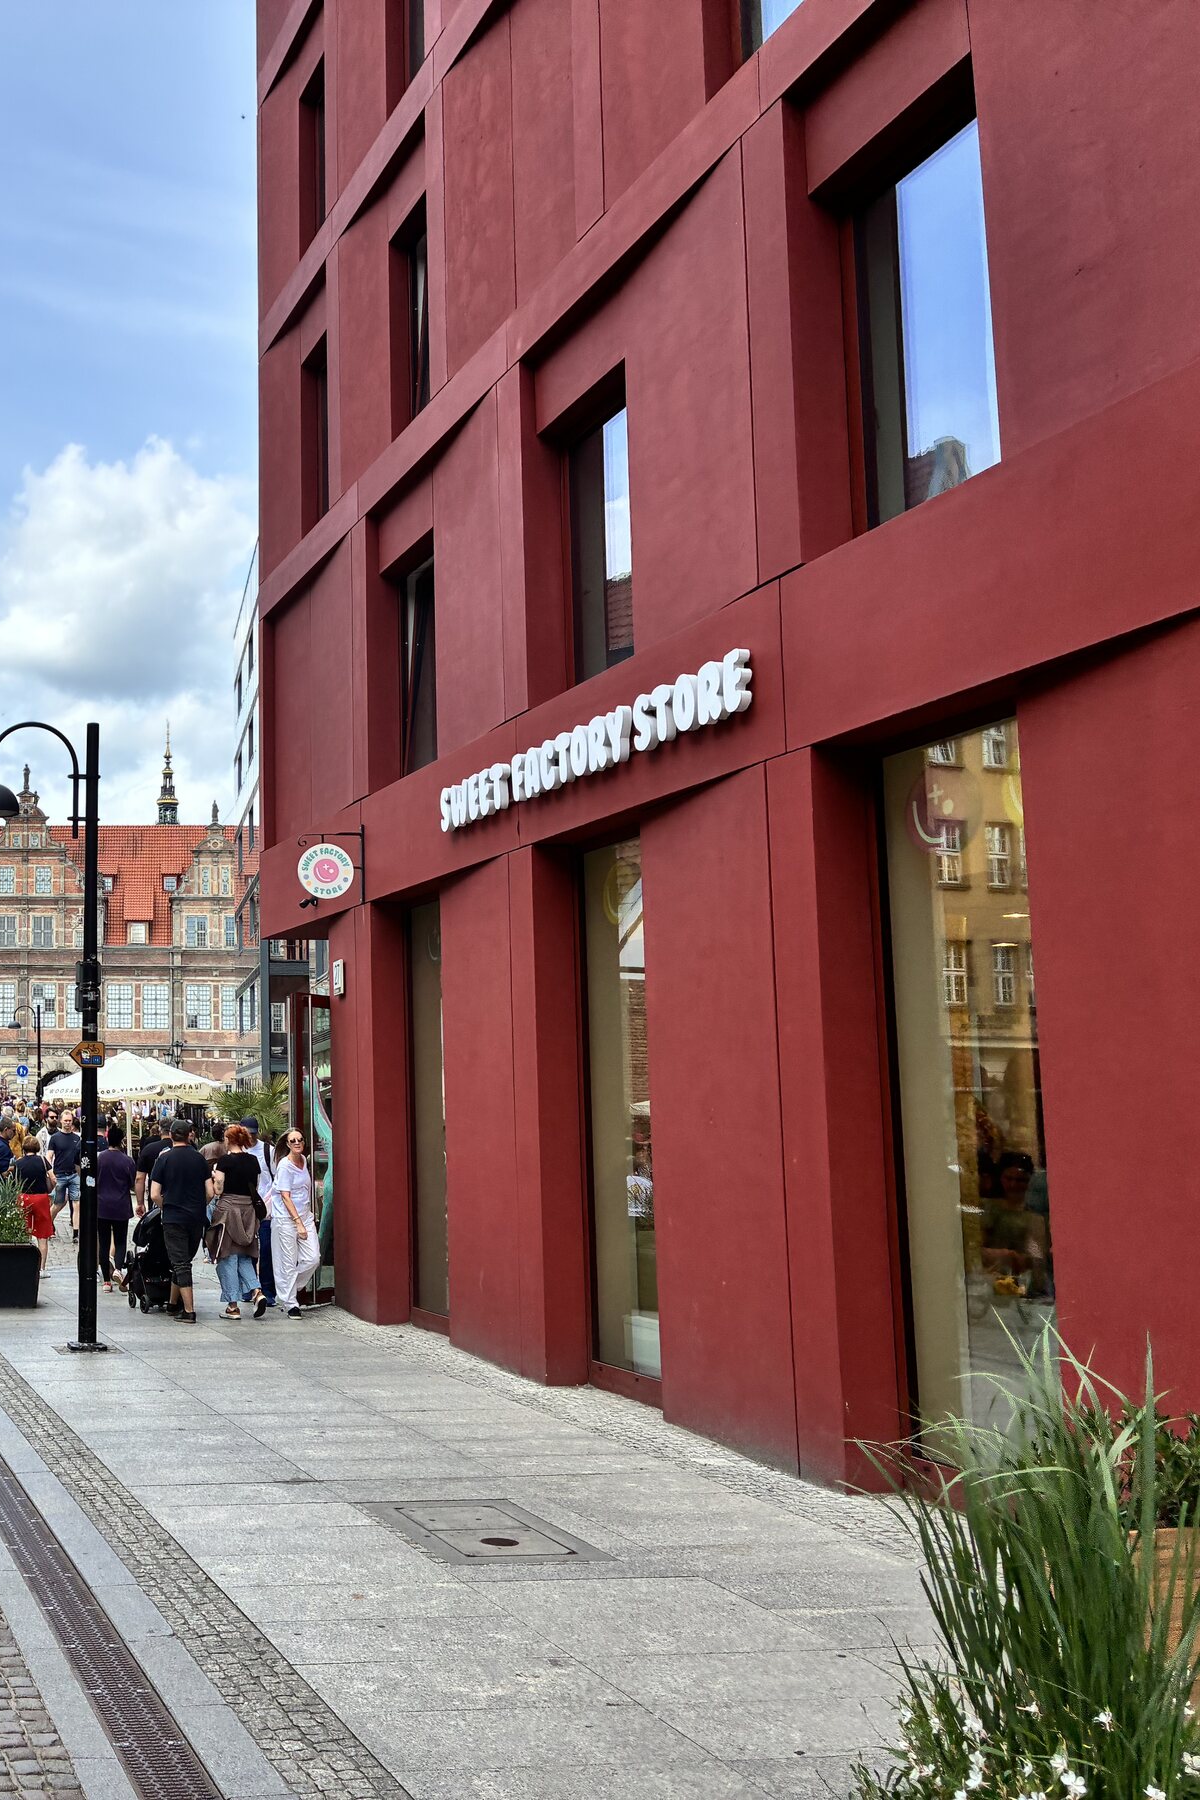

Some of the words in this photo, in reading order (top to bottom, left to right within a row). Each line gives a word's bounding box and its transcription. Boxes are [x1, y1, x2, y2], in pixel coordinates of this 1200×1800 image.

[440, 763, 511, 832] SWEET
[511, 705, 632, 801] FACTORY
[633, 648, 752, 751] STORE
[302, 850, 318, 871] SWEET
[320, 848, 350, 867] FACTORY
[313, 885, 343, 895] STORE
